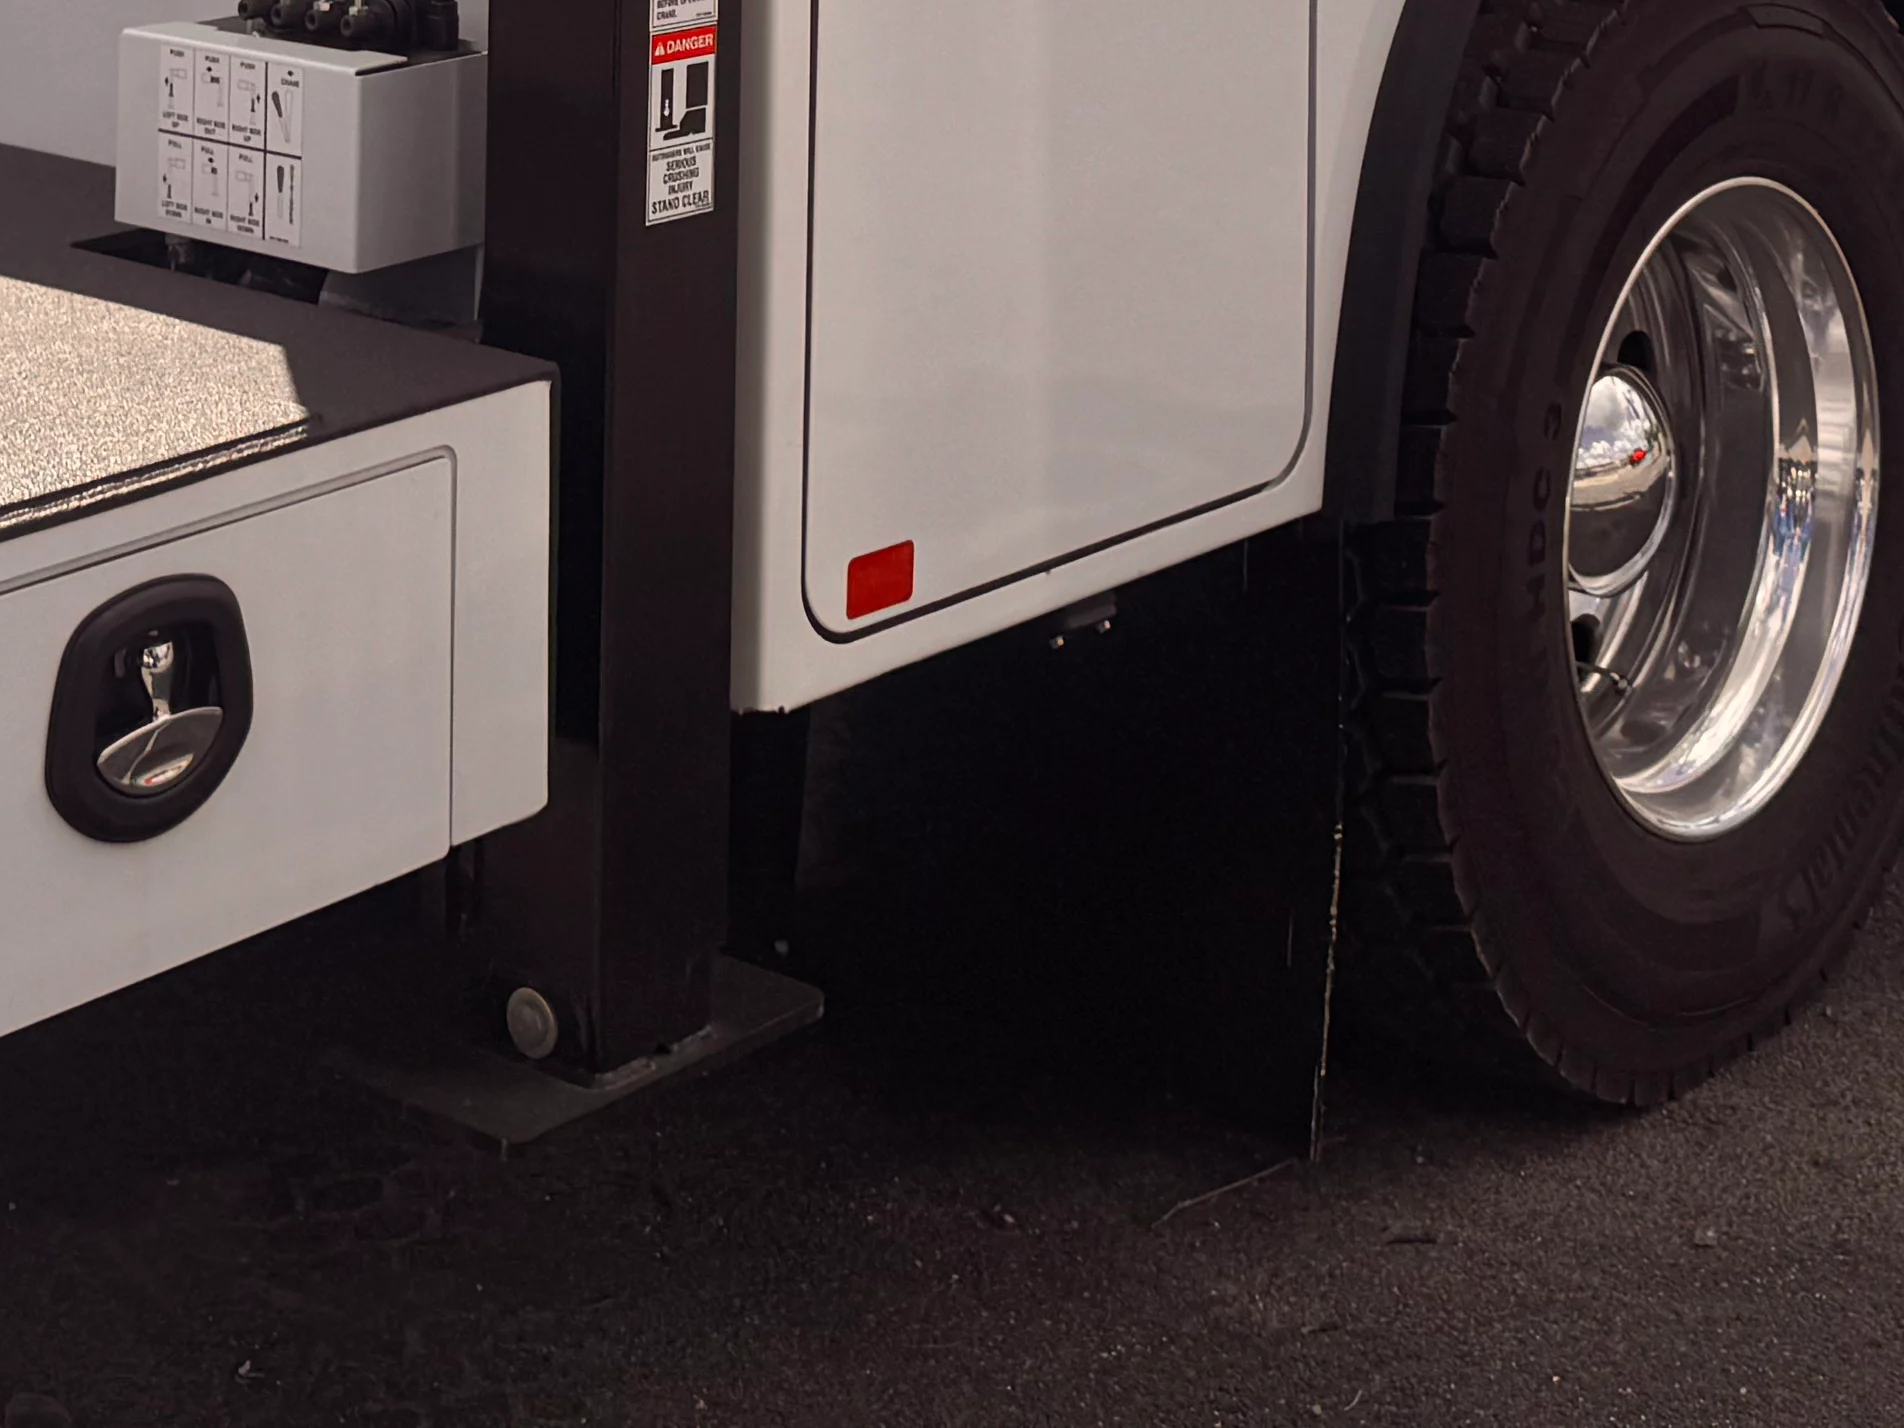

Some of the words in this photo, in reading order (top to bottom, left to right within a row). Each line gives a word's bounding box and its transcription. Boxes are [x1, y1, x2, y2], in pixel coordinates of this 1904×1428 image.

[666, 33, 714, 54] DANGER
[666, 155, 696, 172] SERIOUS
[663, 167, 699, 184] CRUSHING
[668, 180, 693, 195] INJURY
[651, 196, 680, 214] STAND
[682, 189, 710, 208] CLEAR
